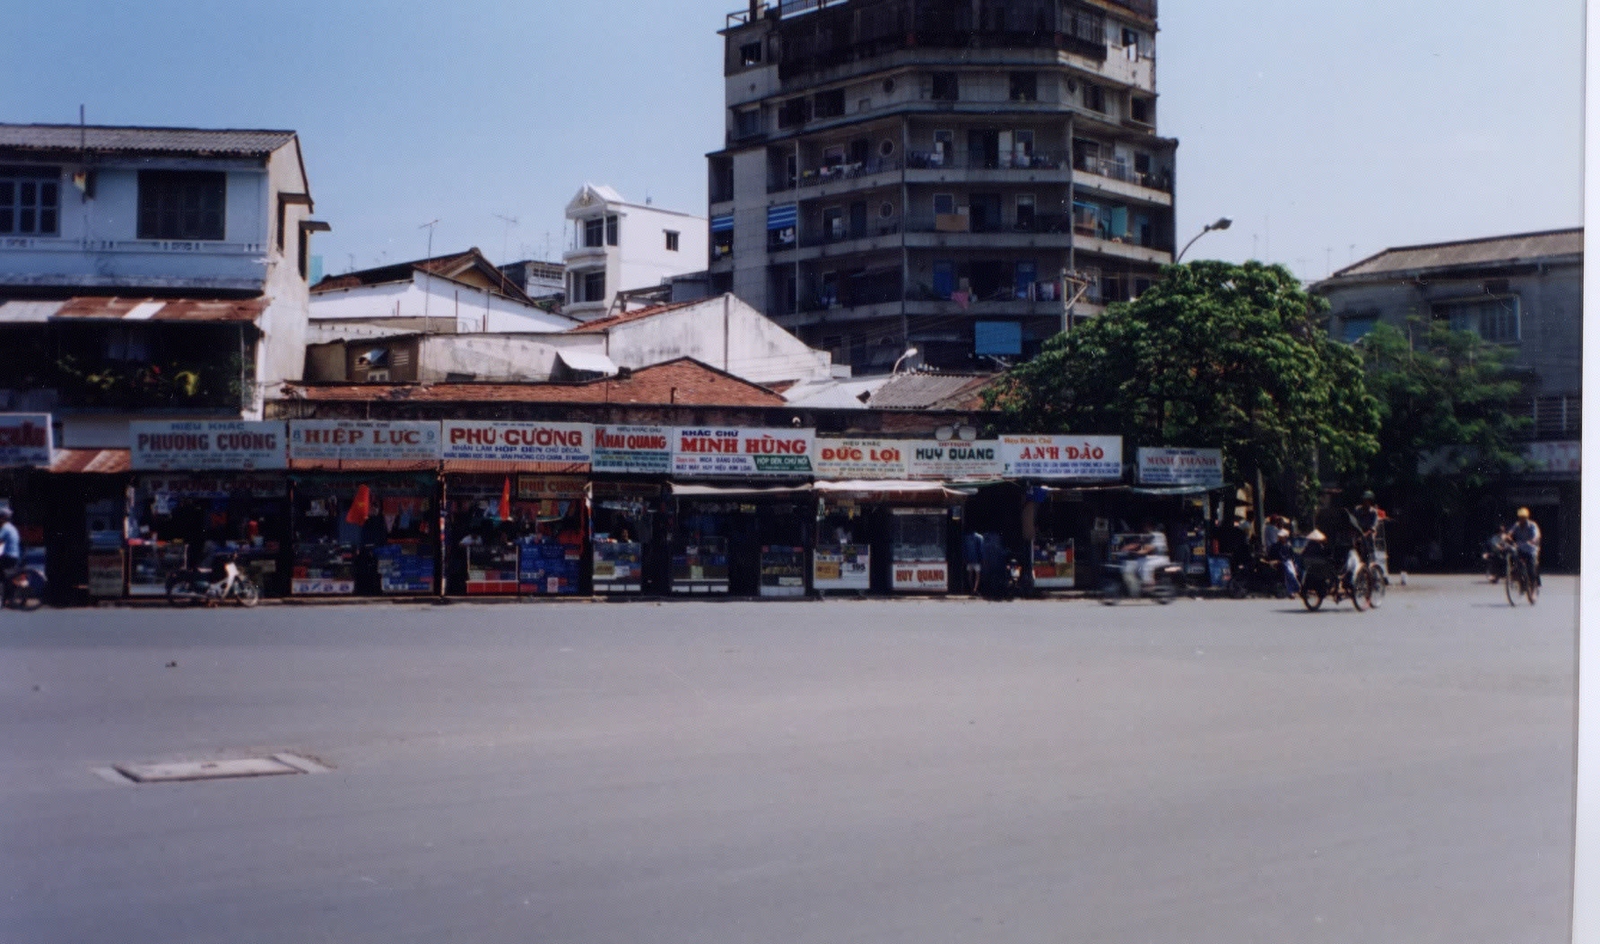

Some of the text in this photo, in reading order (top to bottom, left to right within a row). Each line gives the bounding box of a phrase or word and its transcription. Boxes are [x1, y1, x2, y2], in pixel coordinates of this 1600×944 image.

[426, 430, 435, 440] 9
[504, 427, 582, 446] CƯỜNG
[595, 428, 667, 449] KHAI QUANG
[681, 434, 807, 454] MINH HÙNG
[870, 446, 900, 464] LỢI
[916, 448, 994, 460] HUY QUANG
[1020, 442, 1104, 460] ANH ĐÀO
[896, 569, 944, 583] HUY QUANG
